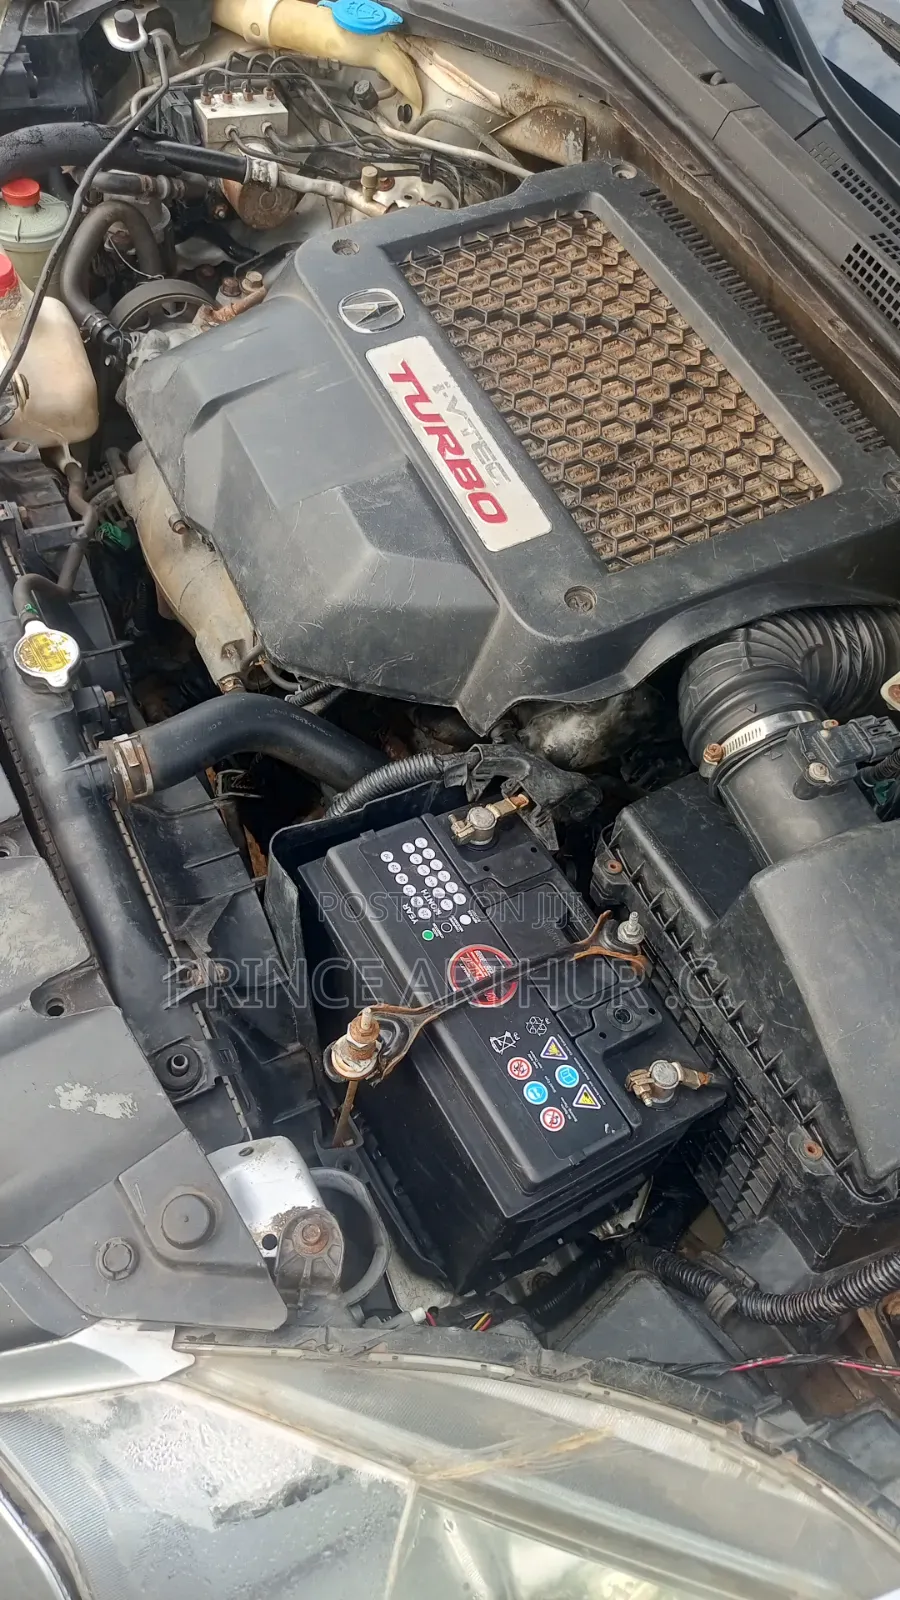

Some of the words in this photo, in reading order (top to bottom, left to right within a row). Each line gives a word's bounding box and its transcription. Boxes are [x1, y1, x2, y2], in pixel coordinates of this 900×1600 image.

[388, 359, 509, 524] TURBO
[402, 903, 418, 925] YEAR
[420, 888, 442, 916] MONTH
[513, 1032, 520, 1040] Pb
